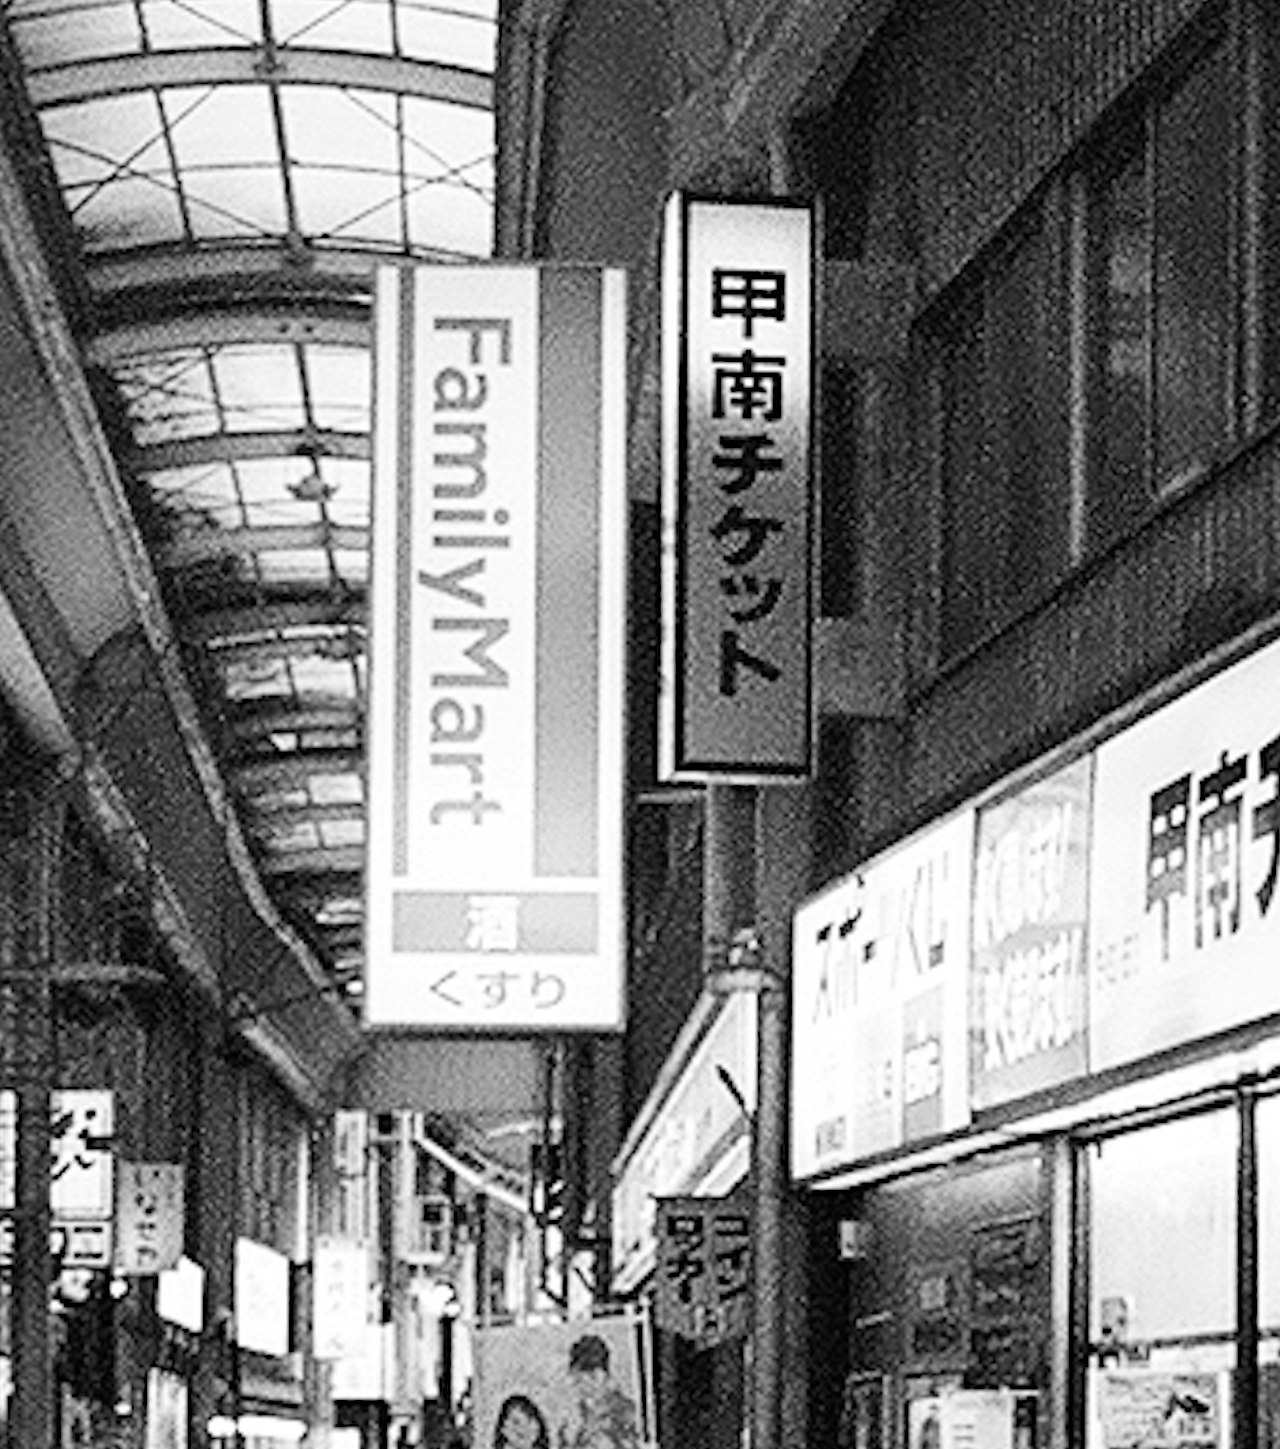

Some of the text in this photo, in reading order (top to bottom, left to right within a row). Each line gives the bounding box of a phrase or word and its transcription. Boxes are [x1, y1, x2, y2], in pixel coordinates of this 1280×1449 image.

[417, 314, 513, 829] FamilyMart
[709, 267, 788, 698] 甲南チケット
[429, 969, 567, 1010] くすり
[465, 895, 522, 950] 酒
